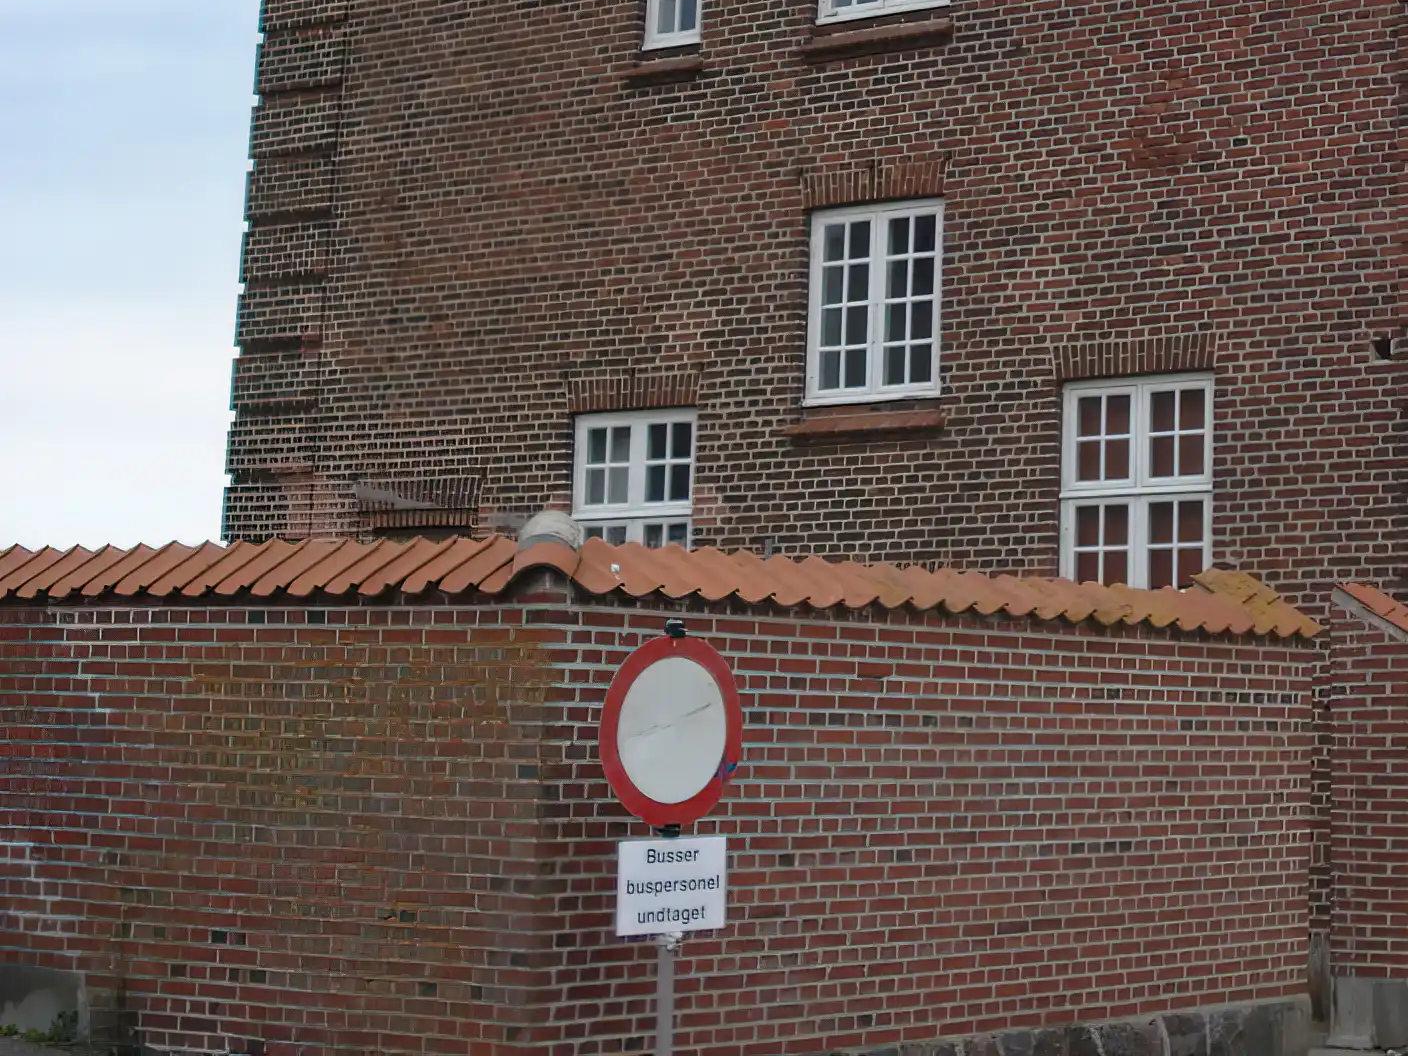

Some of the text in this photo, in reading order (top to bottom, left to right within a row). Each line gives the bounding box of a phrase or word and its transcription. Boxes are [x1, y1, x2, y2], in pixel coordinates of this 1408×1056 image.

[646, 848, 699, 864] Busser
[626, 874, 720, 897] buspersonel
[637, 906, 705, 924] undtaget
